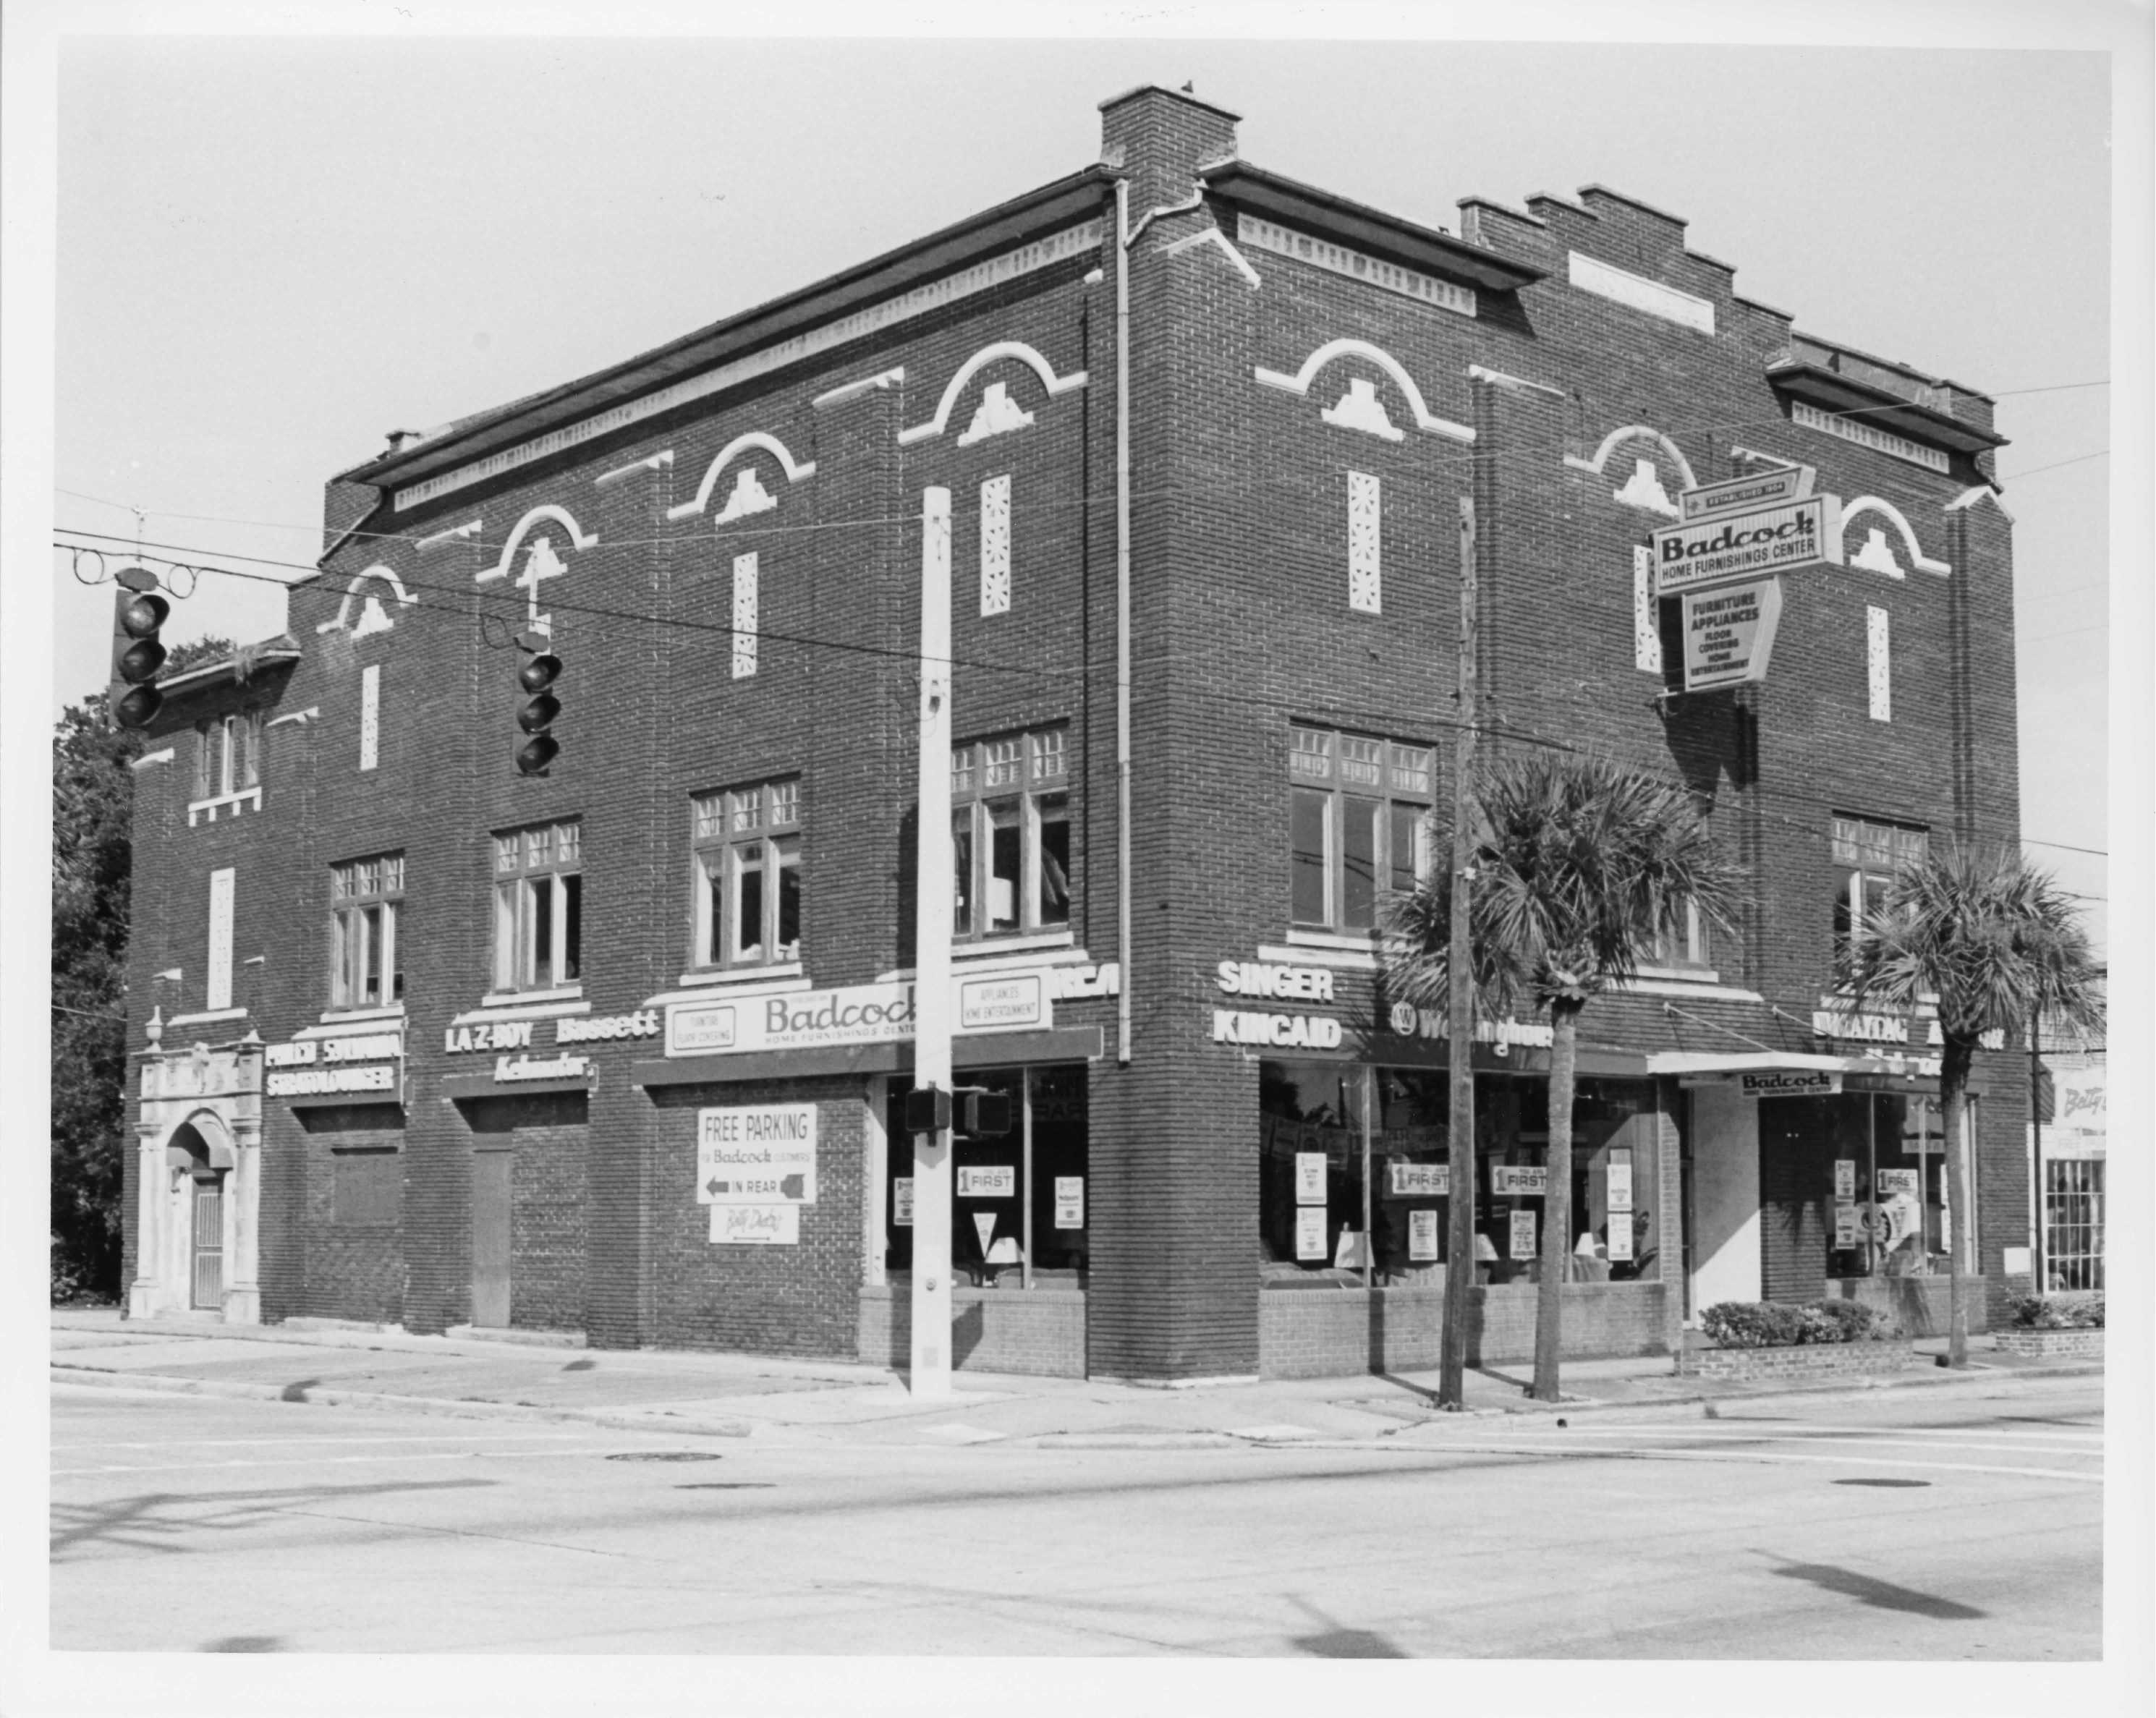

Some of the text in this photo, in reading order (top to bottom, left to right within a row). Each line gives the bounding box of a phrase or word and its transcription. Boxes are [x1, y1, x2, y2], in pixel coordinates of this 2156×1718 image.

[1710, 488, 1762, 505] ESTABLISHED
[1662, 510, 1814, 562] Badcock
[1663, 538, 1815, 579] HOME FURNISHINGS CENTER
[1692, 592, 1756, 616] FURNITURE
[1691, 608, 1759, 631] APPLIANCES
[1705, 629, 1731, 641] FLOOR
[1707, 650, 1731, 663] HOME
[1691, 658, 1749, 676] ENTERTAINMENT
[1051, 963, 1120, 998] RCA
[1218, 961, 1333, 1000] SINGER
[556, 1010, 660, 1042] Bassett
[765, 1024, 915, 1044] HOME FURNISHINGS CENTE
[1213, 1009, 1342, 1047] KINCAID
[1742, 1071, 1831, 1089] Badcock
[705, 1113, 807, 1142] FREE PARKING
[713, 1148, 772, 1164] Badcock
[732, 1180, 777, 1194] IN REAR
[971, 1175, 1011, 1187] FIRST
[1408, 1173, 1448, 1186] FIRST
[1508, 1174, 1547, 1187] FIRST
